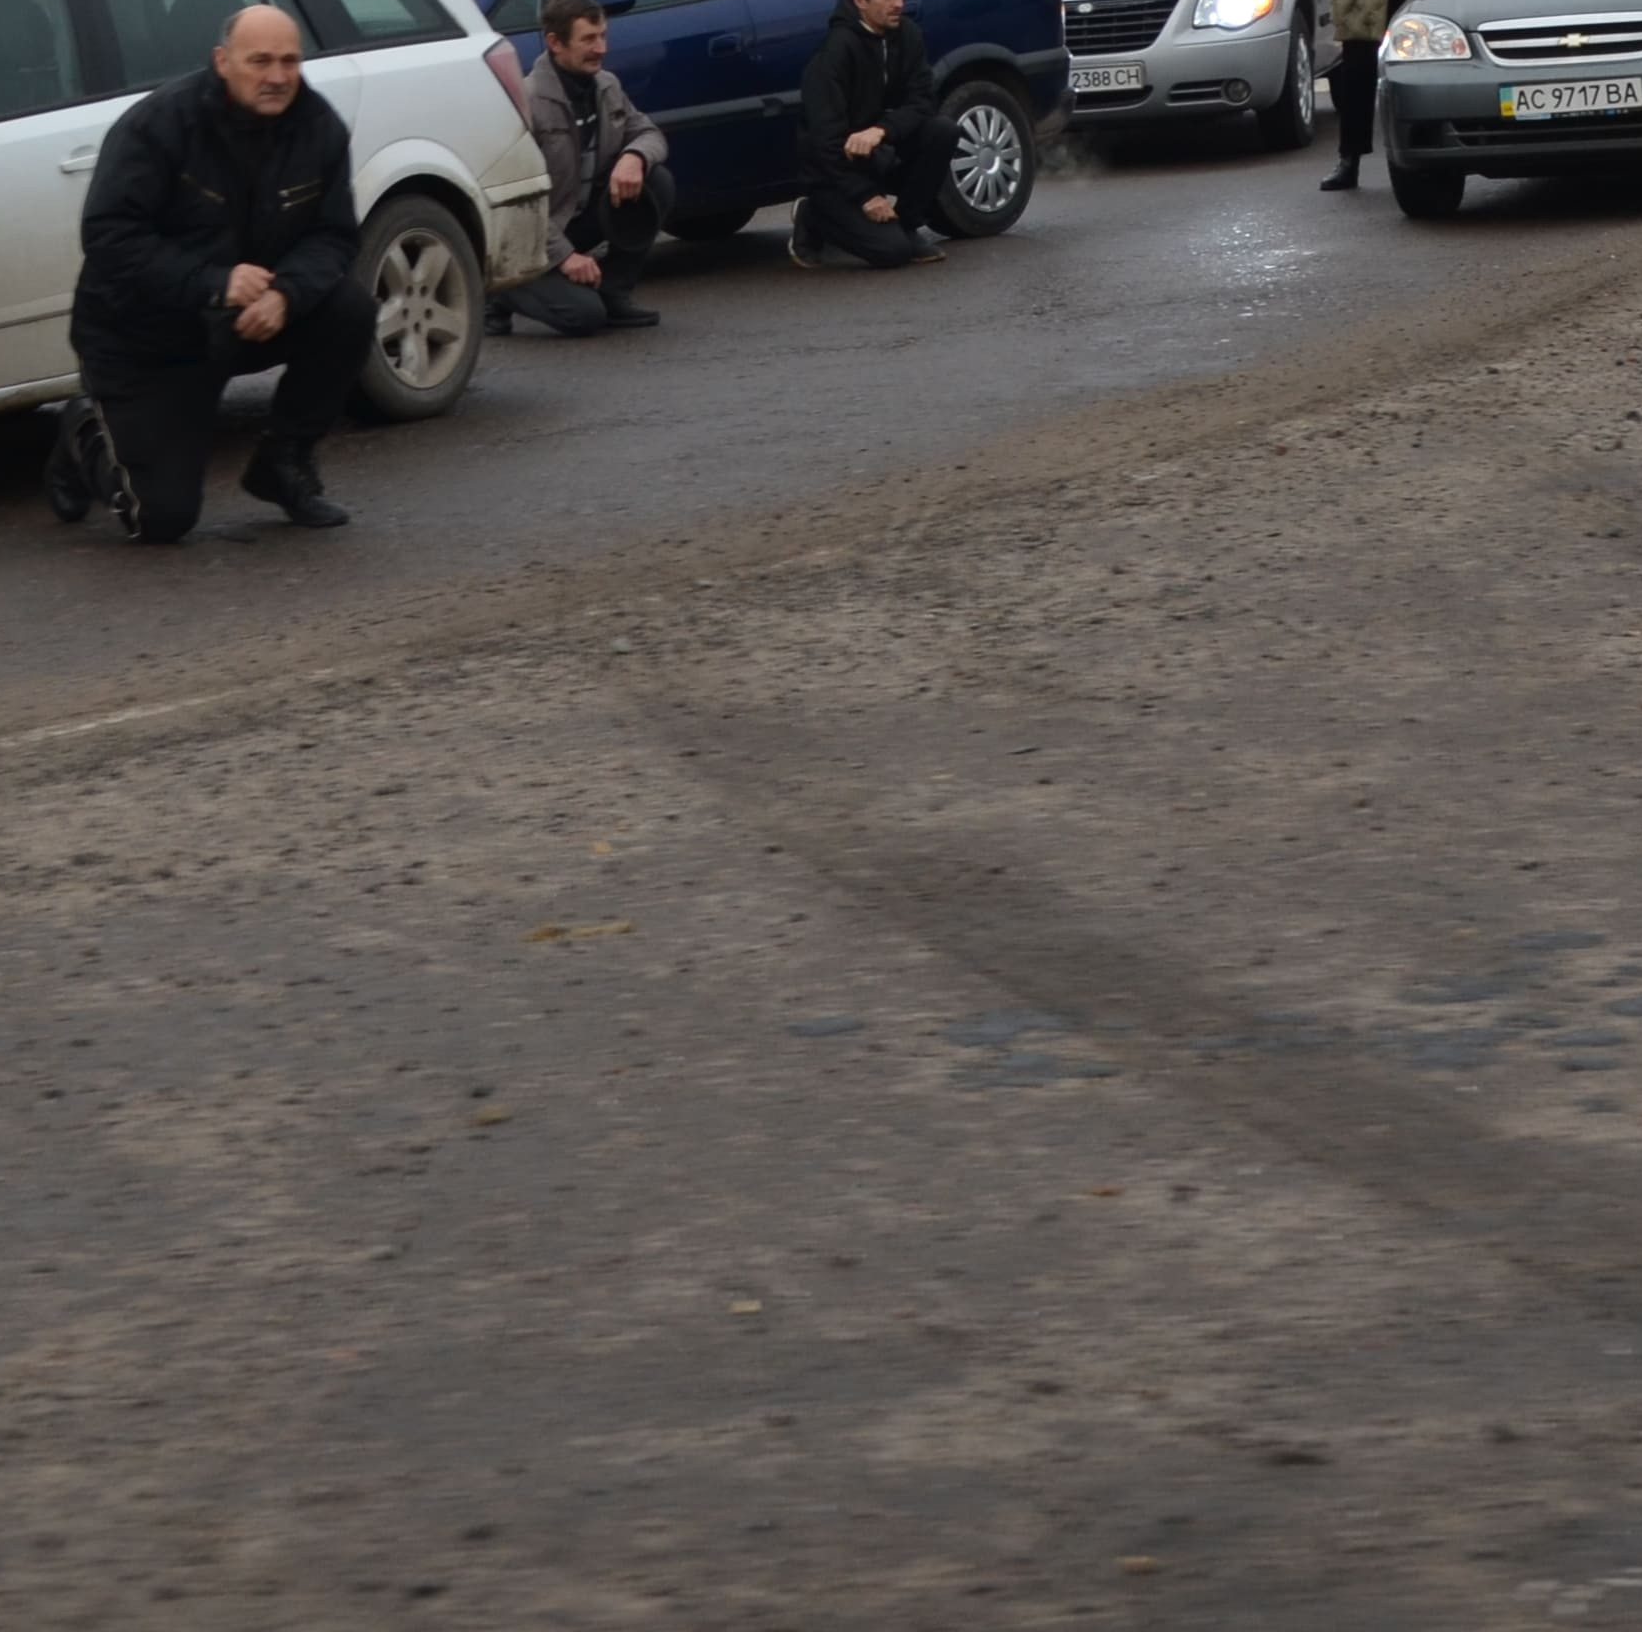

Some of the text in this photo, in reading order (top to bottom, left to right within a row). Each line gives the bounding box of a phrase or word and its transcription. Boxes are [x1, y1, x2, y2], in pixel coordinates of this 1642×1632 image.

[1071, 69, 1140, 88] 2388 CH
[1516, 82, 1639, 111] AC 9717 BA
